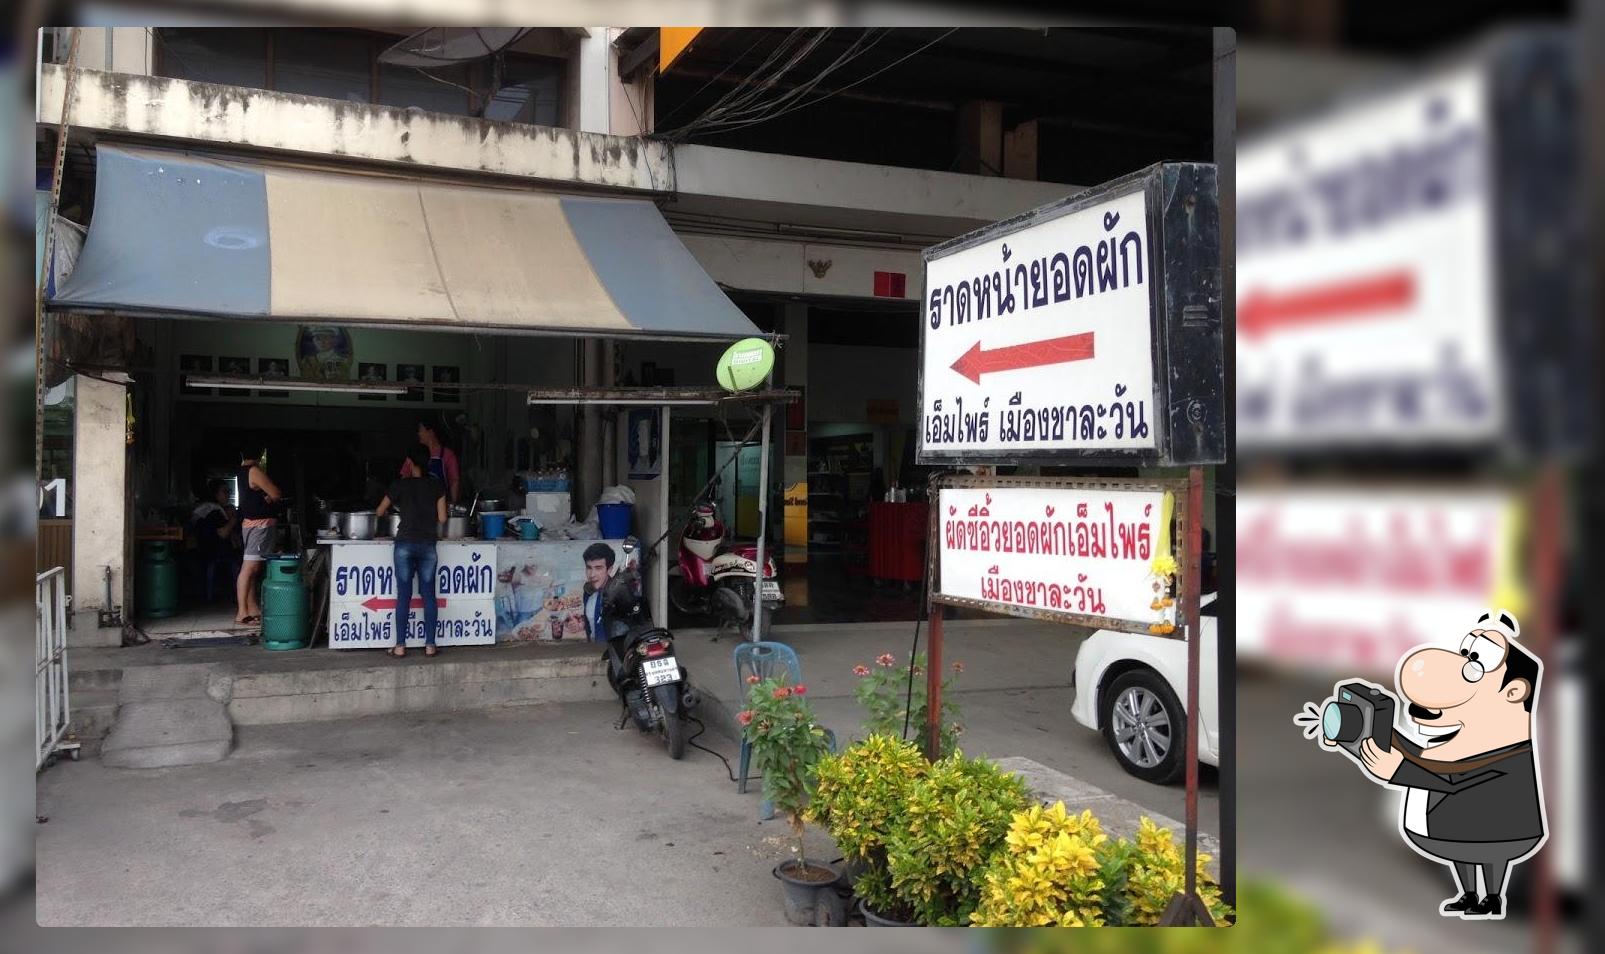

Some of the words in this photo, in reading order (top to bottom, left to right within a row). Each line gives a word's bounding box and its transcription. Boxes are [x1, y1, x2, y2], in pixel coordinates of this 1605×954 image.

[930, 211, 1144, 329] ราดหน้ายอดผัก
[925, 396, 990, 443] เอ็มไพร์
[1000, 383, 1149, 442] เมืองชาละวัน
[336, 551, 493, 596] ราดหอดผัก
[981, 565, 1106, 614] เมืองชาละวัน
[334, 611, 393, 642] เอ็มไพร์
